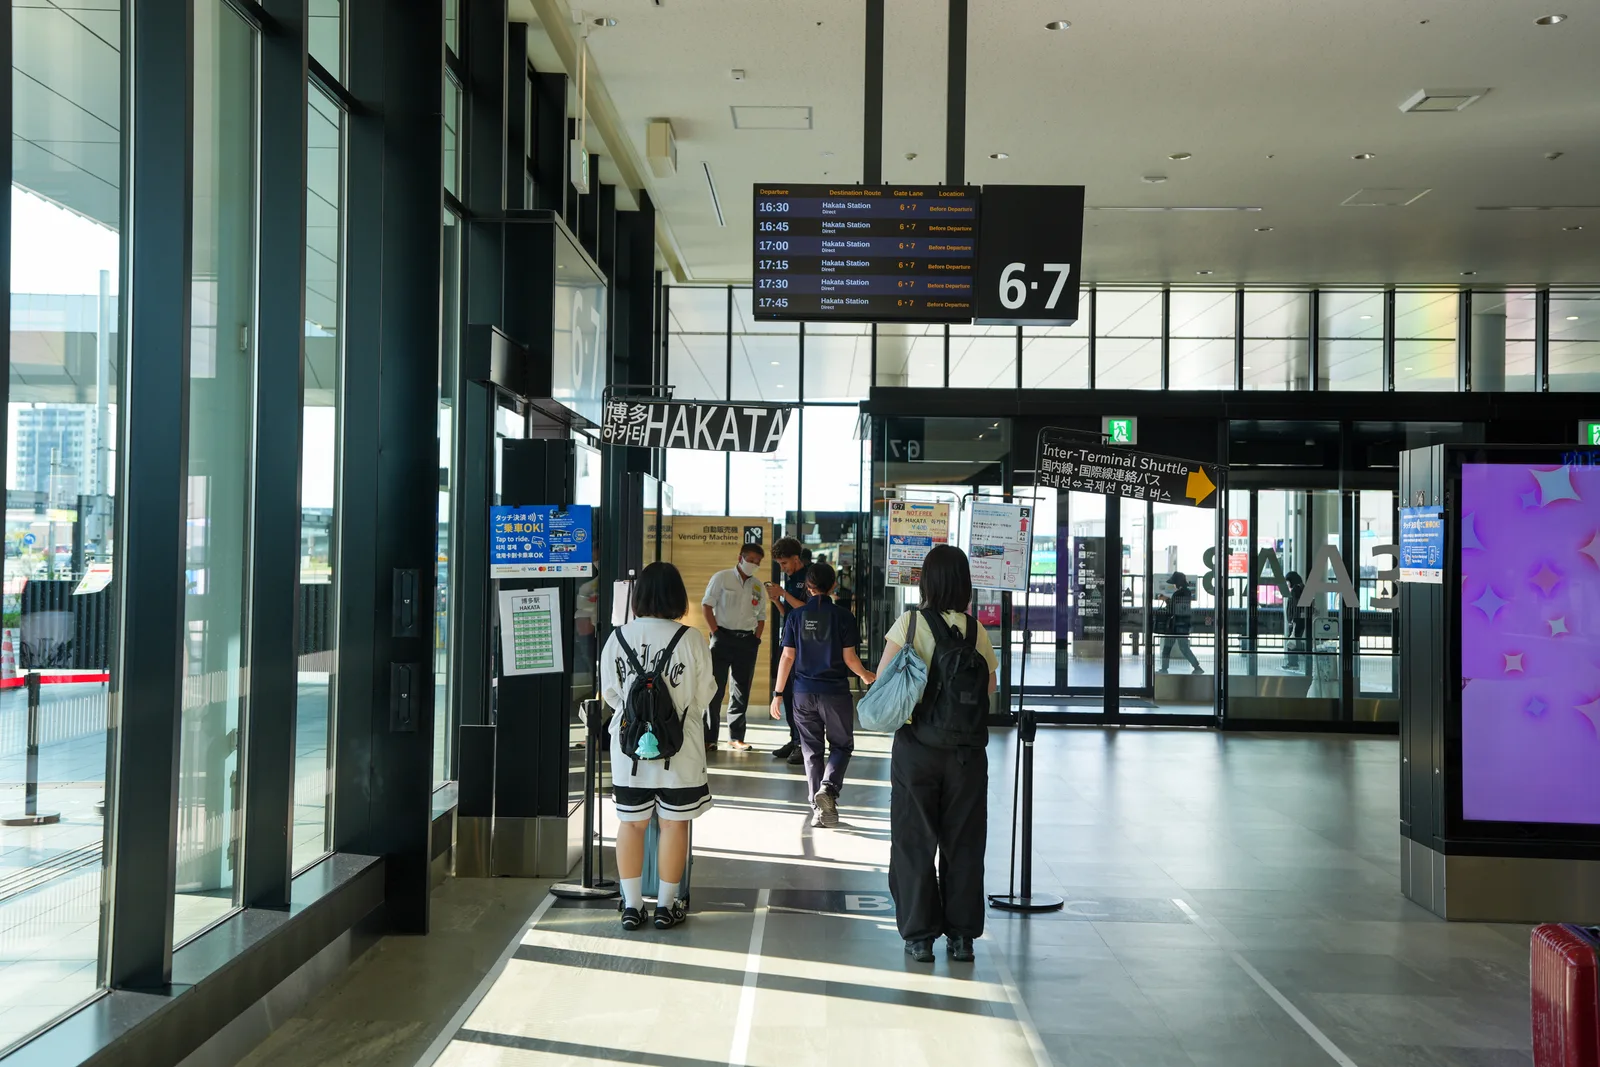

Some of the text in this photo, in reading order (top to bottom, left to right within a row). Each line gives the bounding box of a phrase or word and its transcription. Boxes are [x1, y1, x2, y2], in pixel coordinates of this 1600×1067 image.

[760, 202, 789, 212] 16:30
[760, 222, 789, 231] 16:45
[759, 241, 789, 250] 17:00
[759, 260, 788, 270] 17:15
[759, 279, 788, 289] 17:30
[759, 298, 788, 308] 17:45
[606, 402, 648, 424] 博多
[603, 422, 645, 446] 하카타
[643, 404, 784, 452] HAKATA
[1043, 443, 1188, 476] Inter-Terminal Shuttle
[1120, 484, 1146, 498] 연결
[1150, 488, 1172, 502] 버스
[845, 895, 892, 910] B
